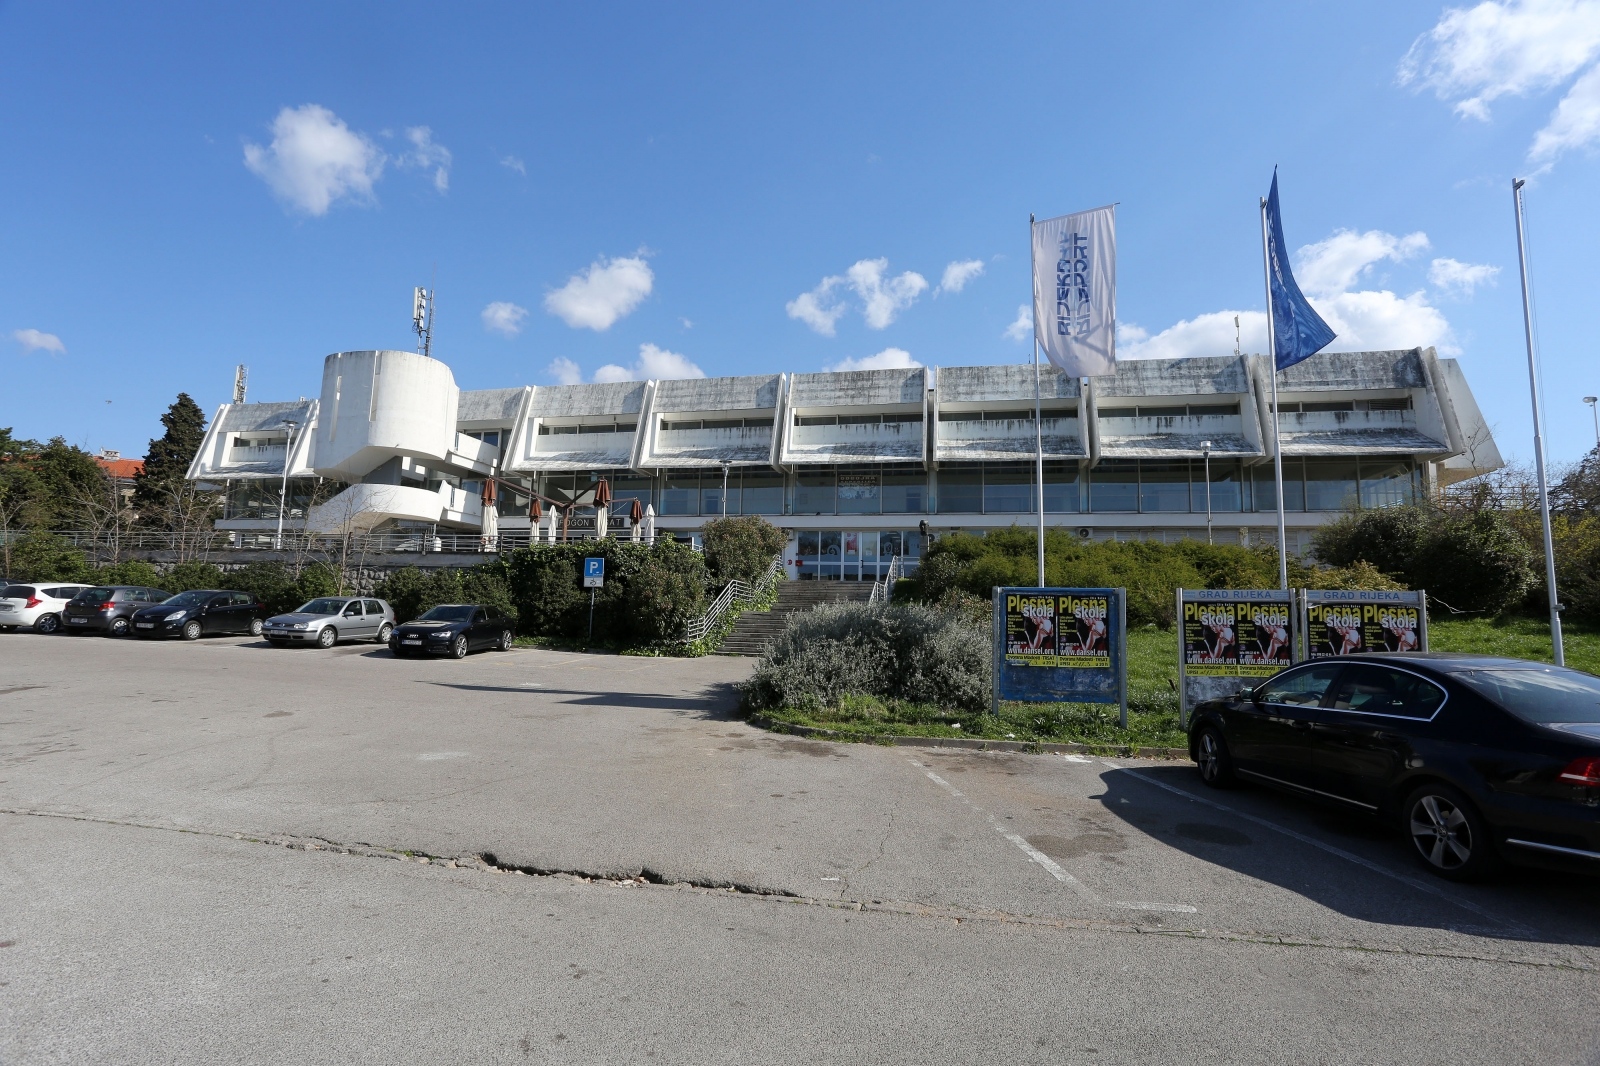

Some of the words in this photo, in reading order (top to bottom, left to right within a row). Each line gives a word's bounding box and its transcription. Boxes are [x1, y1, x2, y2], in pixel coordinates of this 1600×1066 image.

[592, 518, 621, 526] TAT
[589, 561, 599, 574] P
[1198, 590, 1229, 599] GRAD
[1233, 590, 1272, 599] RIJEKA
[1323, 591, 1355, 600] GRAD
[1359, 591, 1400, 600] RIJEKA
[1007, 594, 1055, 613] Plesna
[1059, 595, 1108, 614] Plesna
[1184, 602, 1235, 621] Plesna
[1237, 602, 1289, 621] Plesna
[1309, 604, 1362, 622] Plesna
[1363, 603, 1418, 623] Plesna
[1008, 647, 1055, 656] www.dansel.org
[1060, 648, 1108, 657] www.dansel.org
[1187, 656, 1237, 665] www.dansel.org
[1239, 656, 1290, 667] www.dansel.org
